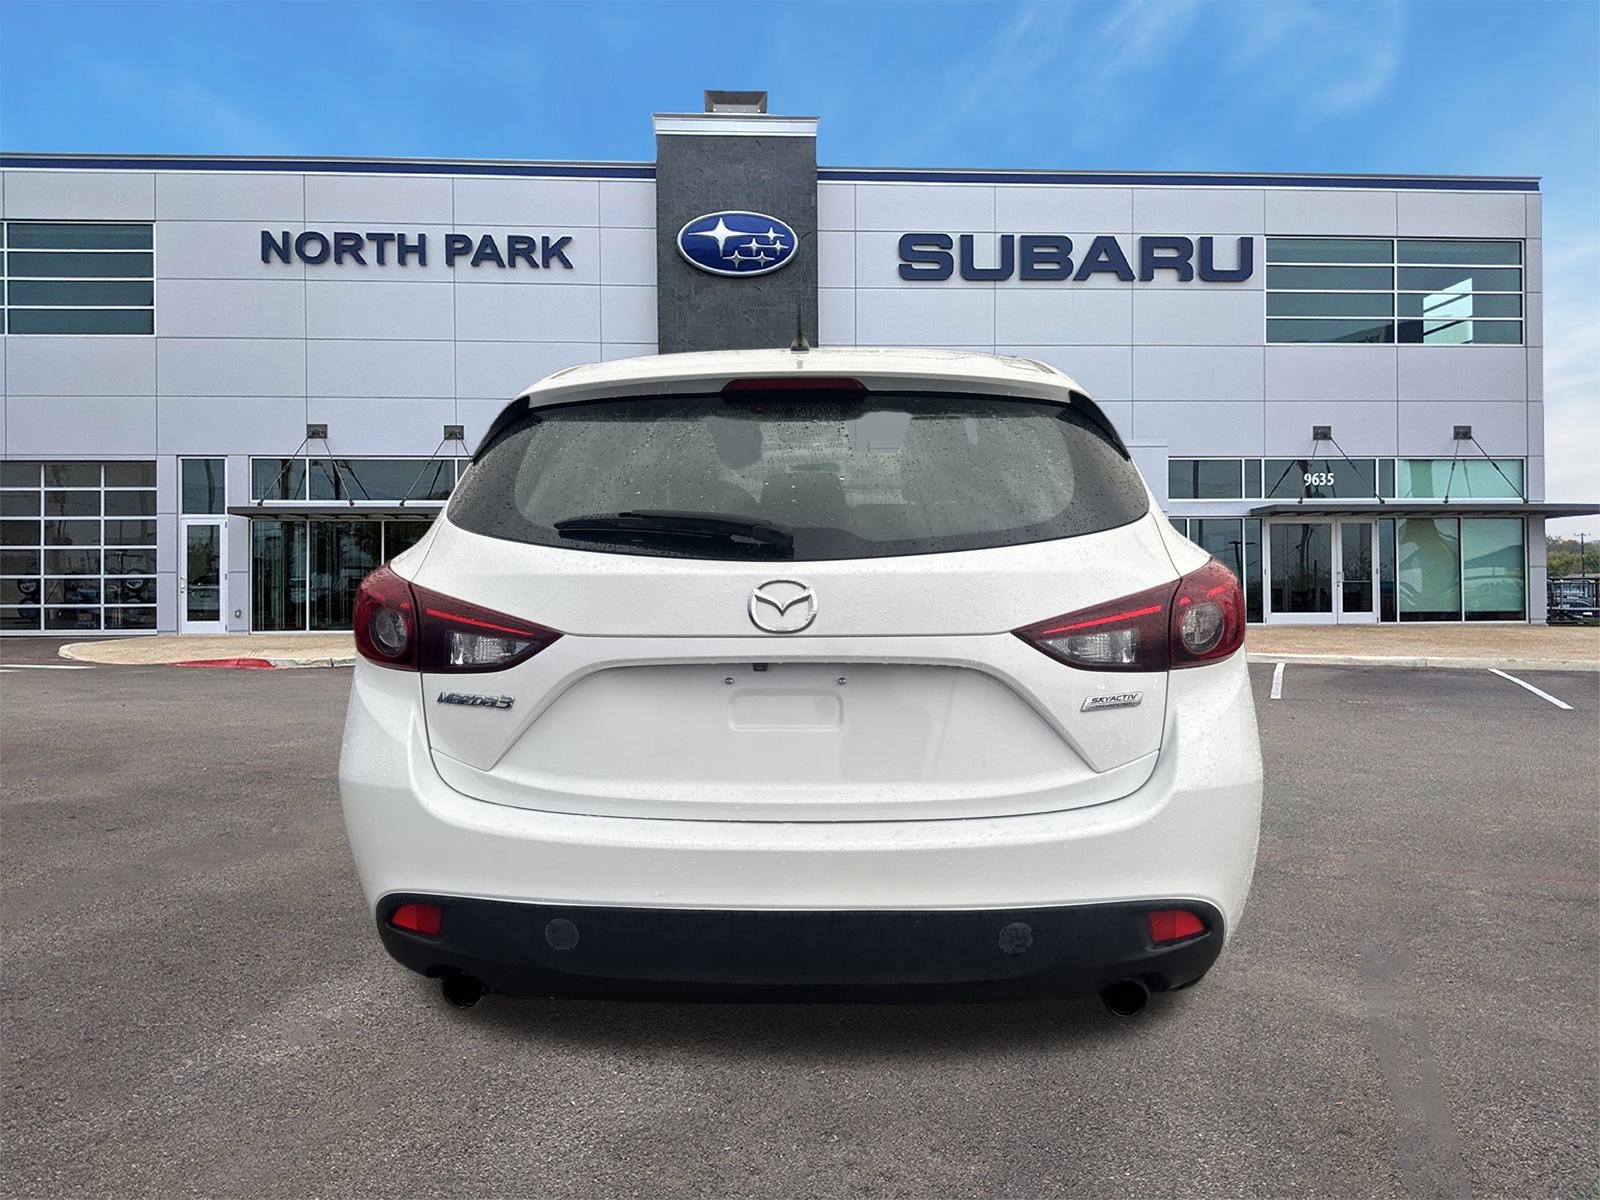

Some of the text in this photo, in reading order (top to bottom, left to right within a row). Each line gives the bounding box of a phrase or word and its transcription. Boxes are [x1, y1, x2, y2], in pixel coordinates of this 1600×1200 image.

[260, 230, 574, 269] NORTH PARK
[898, 232, 1254, 282] SUBARU
[1303, 472, 1334, 486] 9635
[1090, 692, 1139, 704] SKYACTIV
